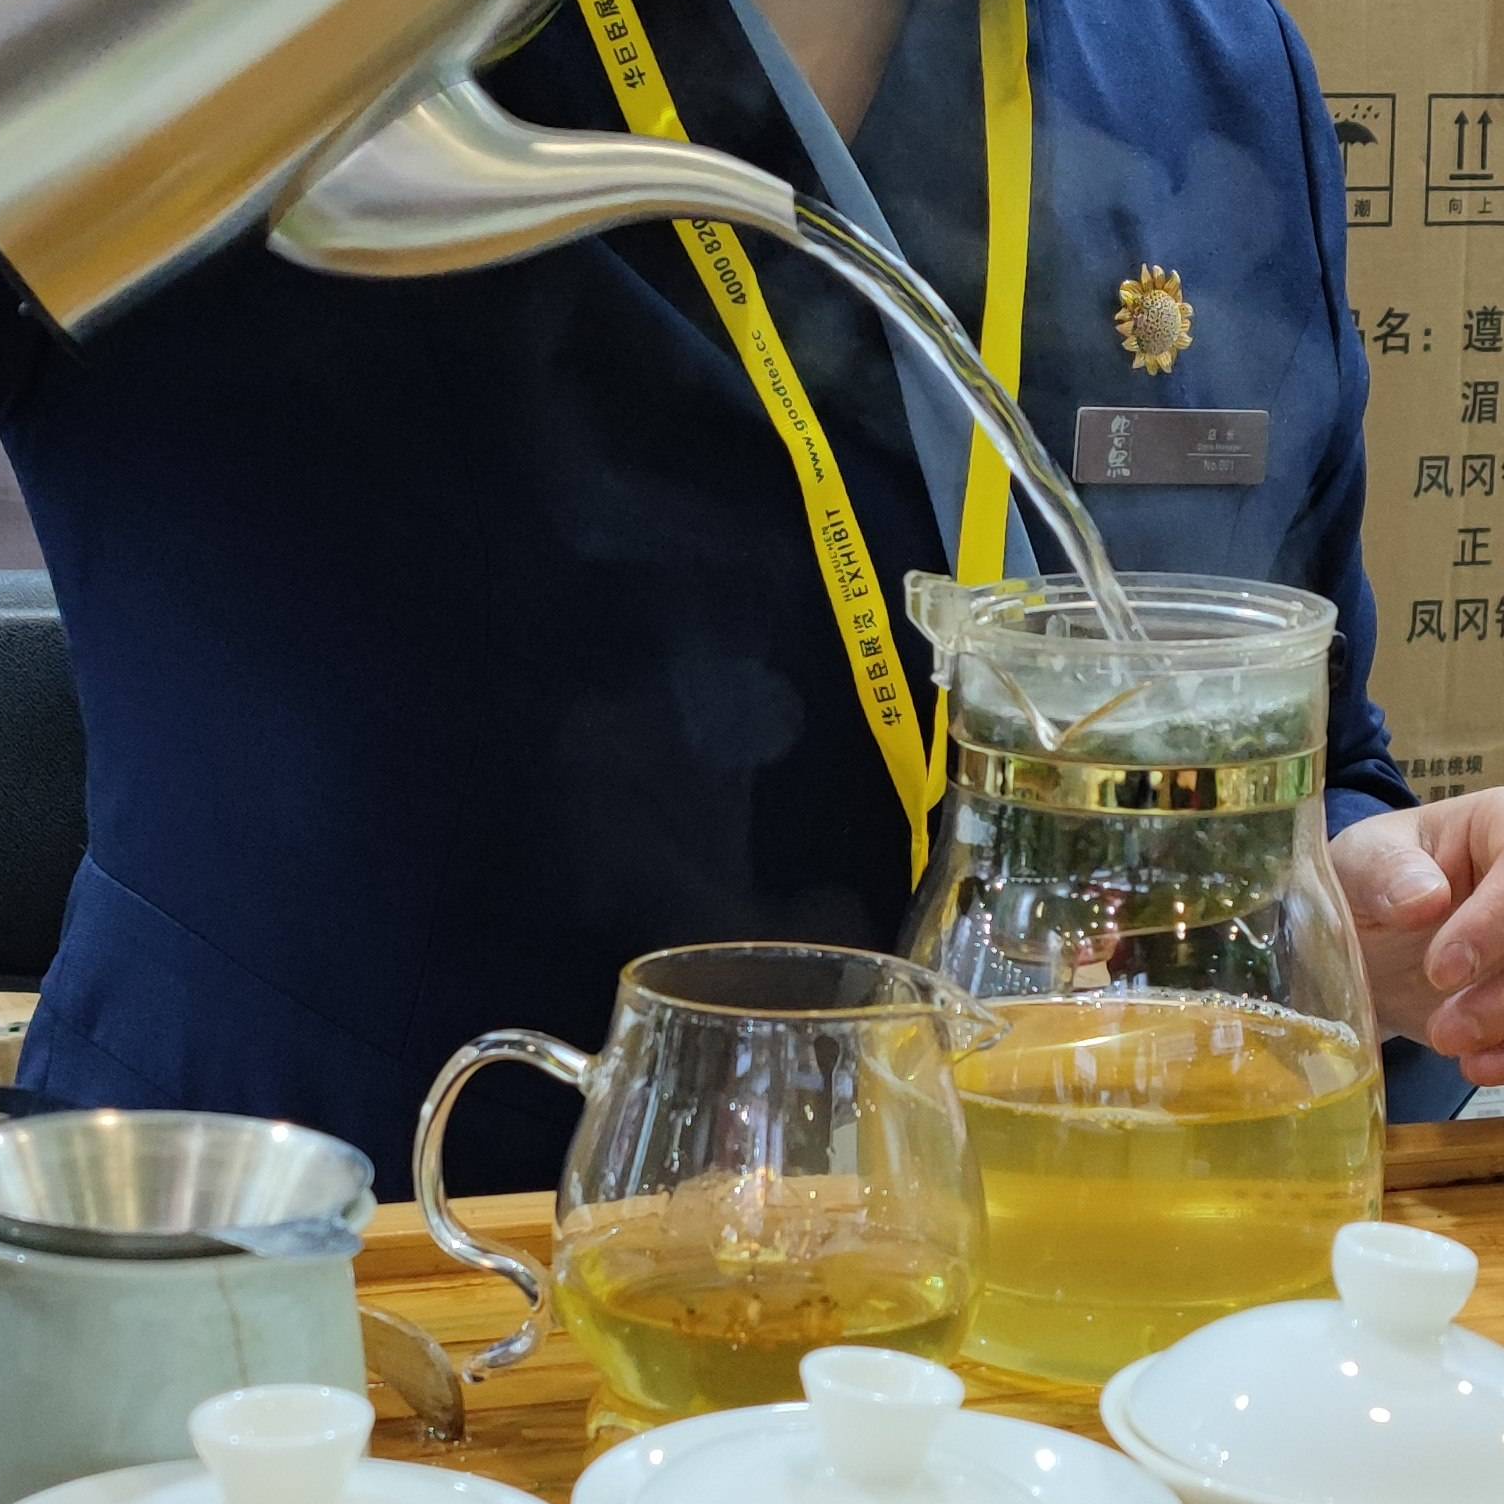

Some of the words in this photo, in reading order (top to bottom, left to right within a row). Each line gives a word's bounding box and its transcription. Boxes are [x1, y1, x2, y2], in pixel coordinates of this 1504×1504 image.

[1448, 196, 1494, 217] 向上
[752, 329, 825, 484] www.goodtea.cc
[825, 508, 868, 601] EXHIBIT
[853, 609, 904, 727] 华巨臣展览
